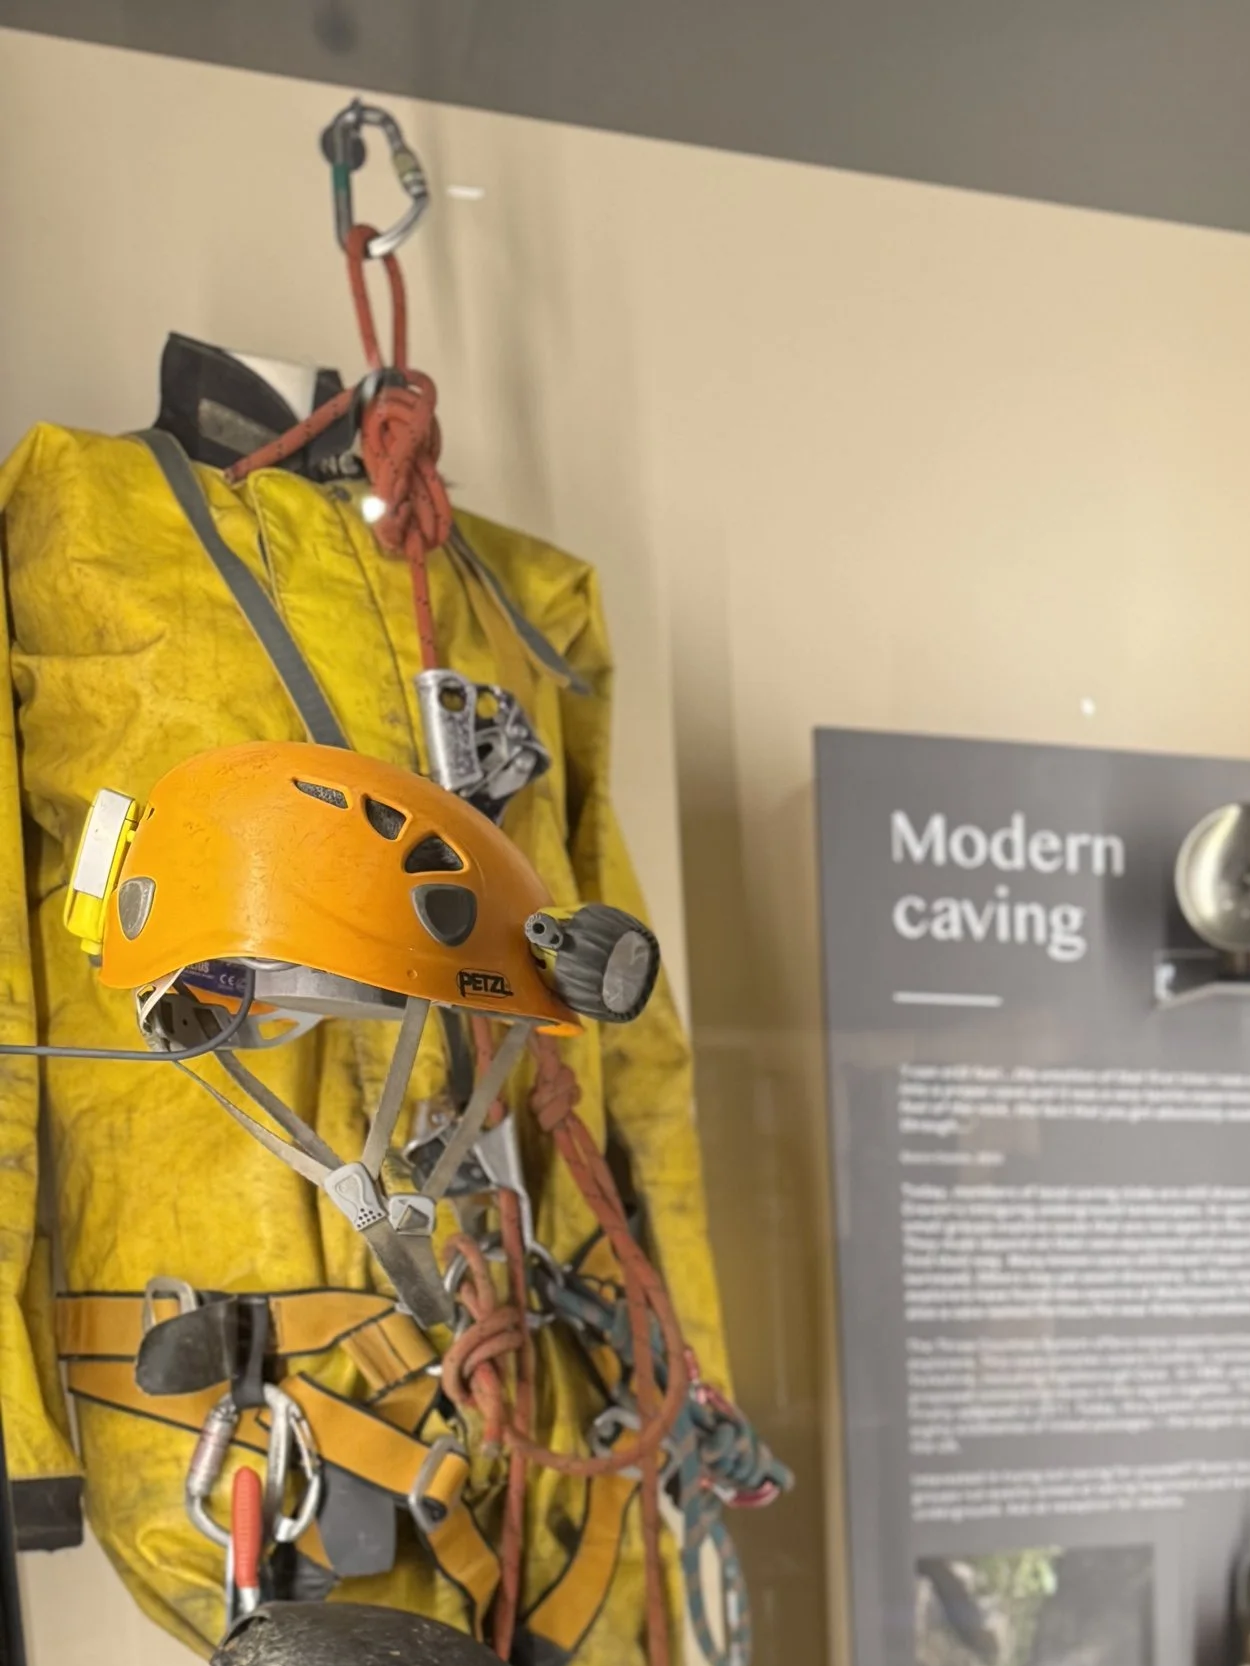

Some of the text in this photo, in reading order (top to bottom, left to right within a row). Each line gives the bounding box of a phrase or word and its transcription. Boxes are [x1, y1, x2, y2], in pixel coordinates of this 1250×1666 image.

[891, 809, 1125, 877] Modern
[893, 884, 1087, 963] caving
[459, 970, 514, 998] PETZL
